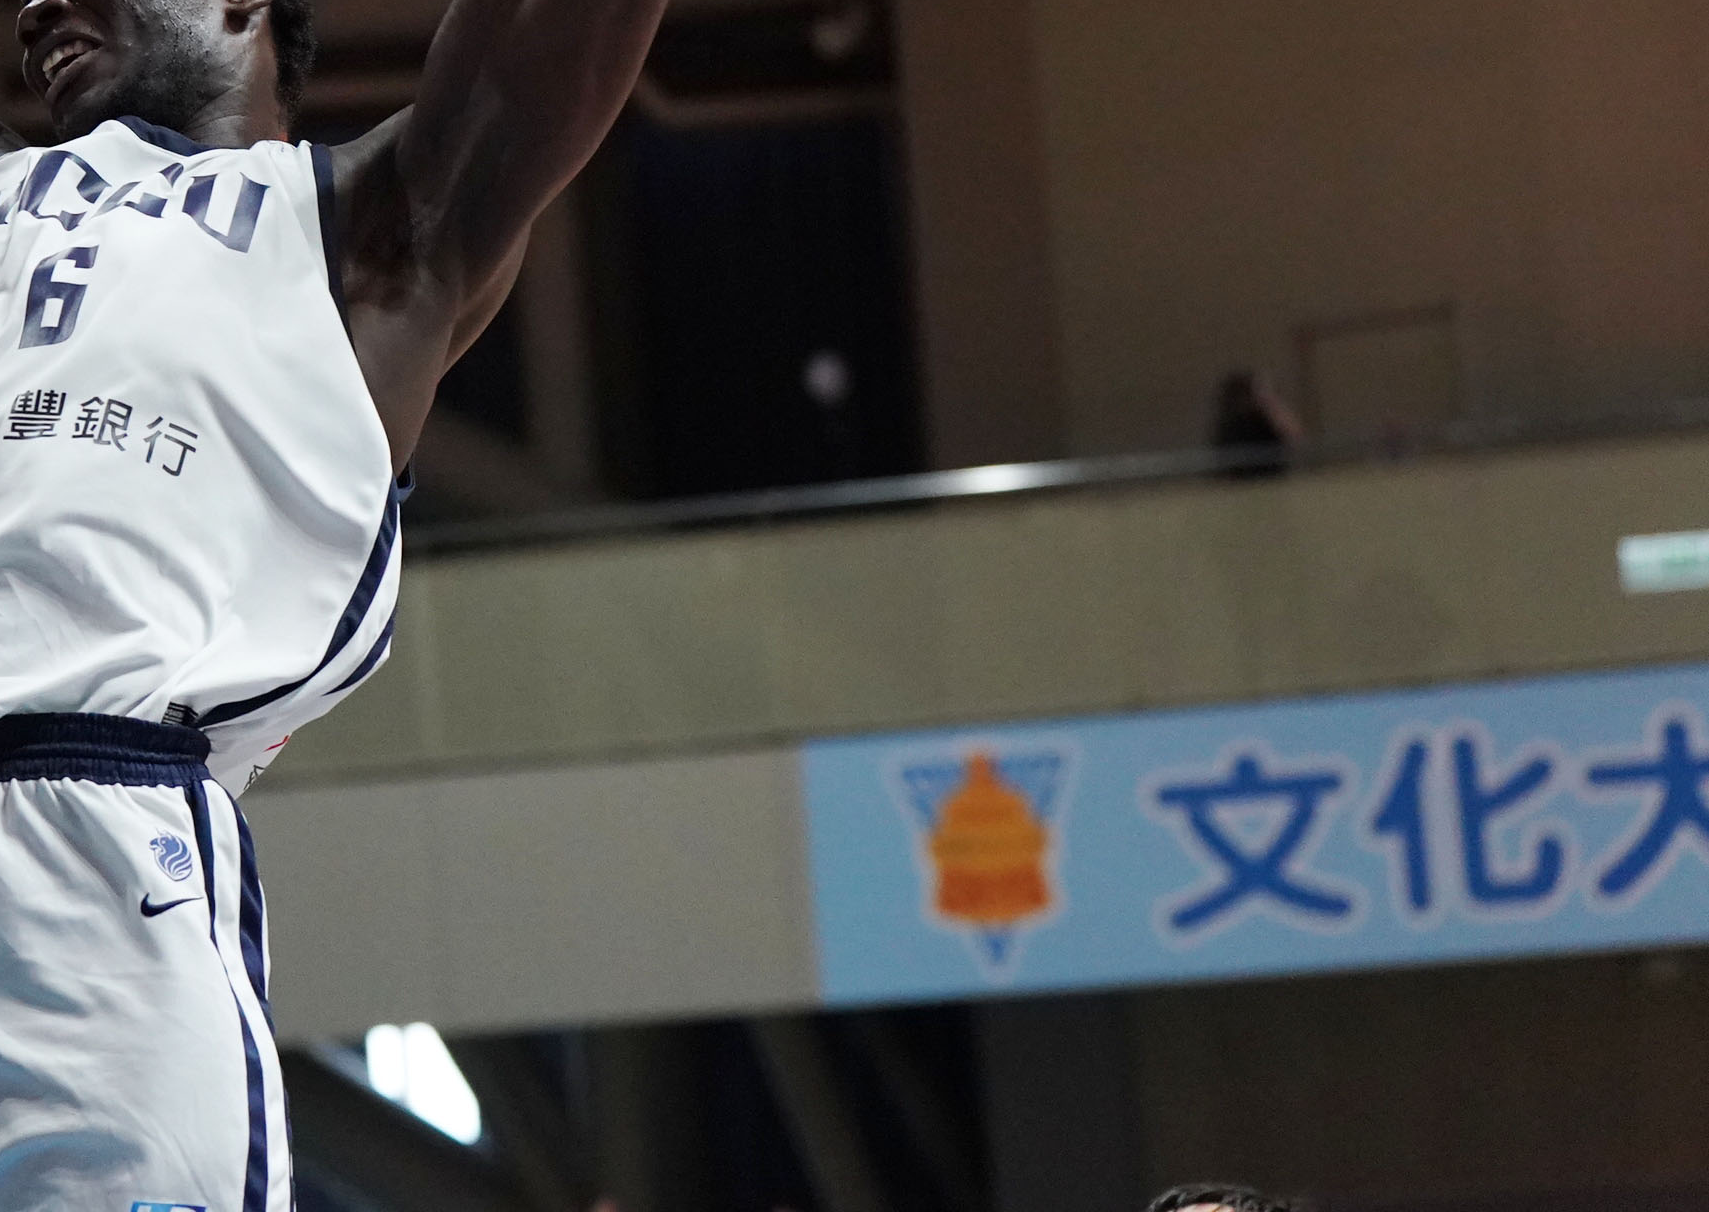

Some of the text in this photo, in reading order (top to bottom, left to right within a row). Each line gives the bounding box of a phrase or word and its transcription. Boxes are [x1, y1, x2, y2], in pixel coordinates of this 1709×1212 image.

[18, 244, 99, 349] 6
[1156, 718, 1709, 930] 文化大
